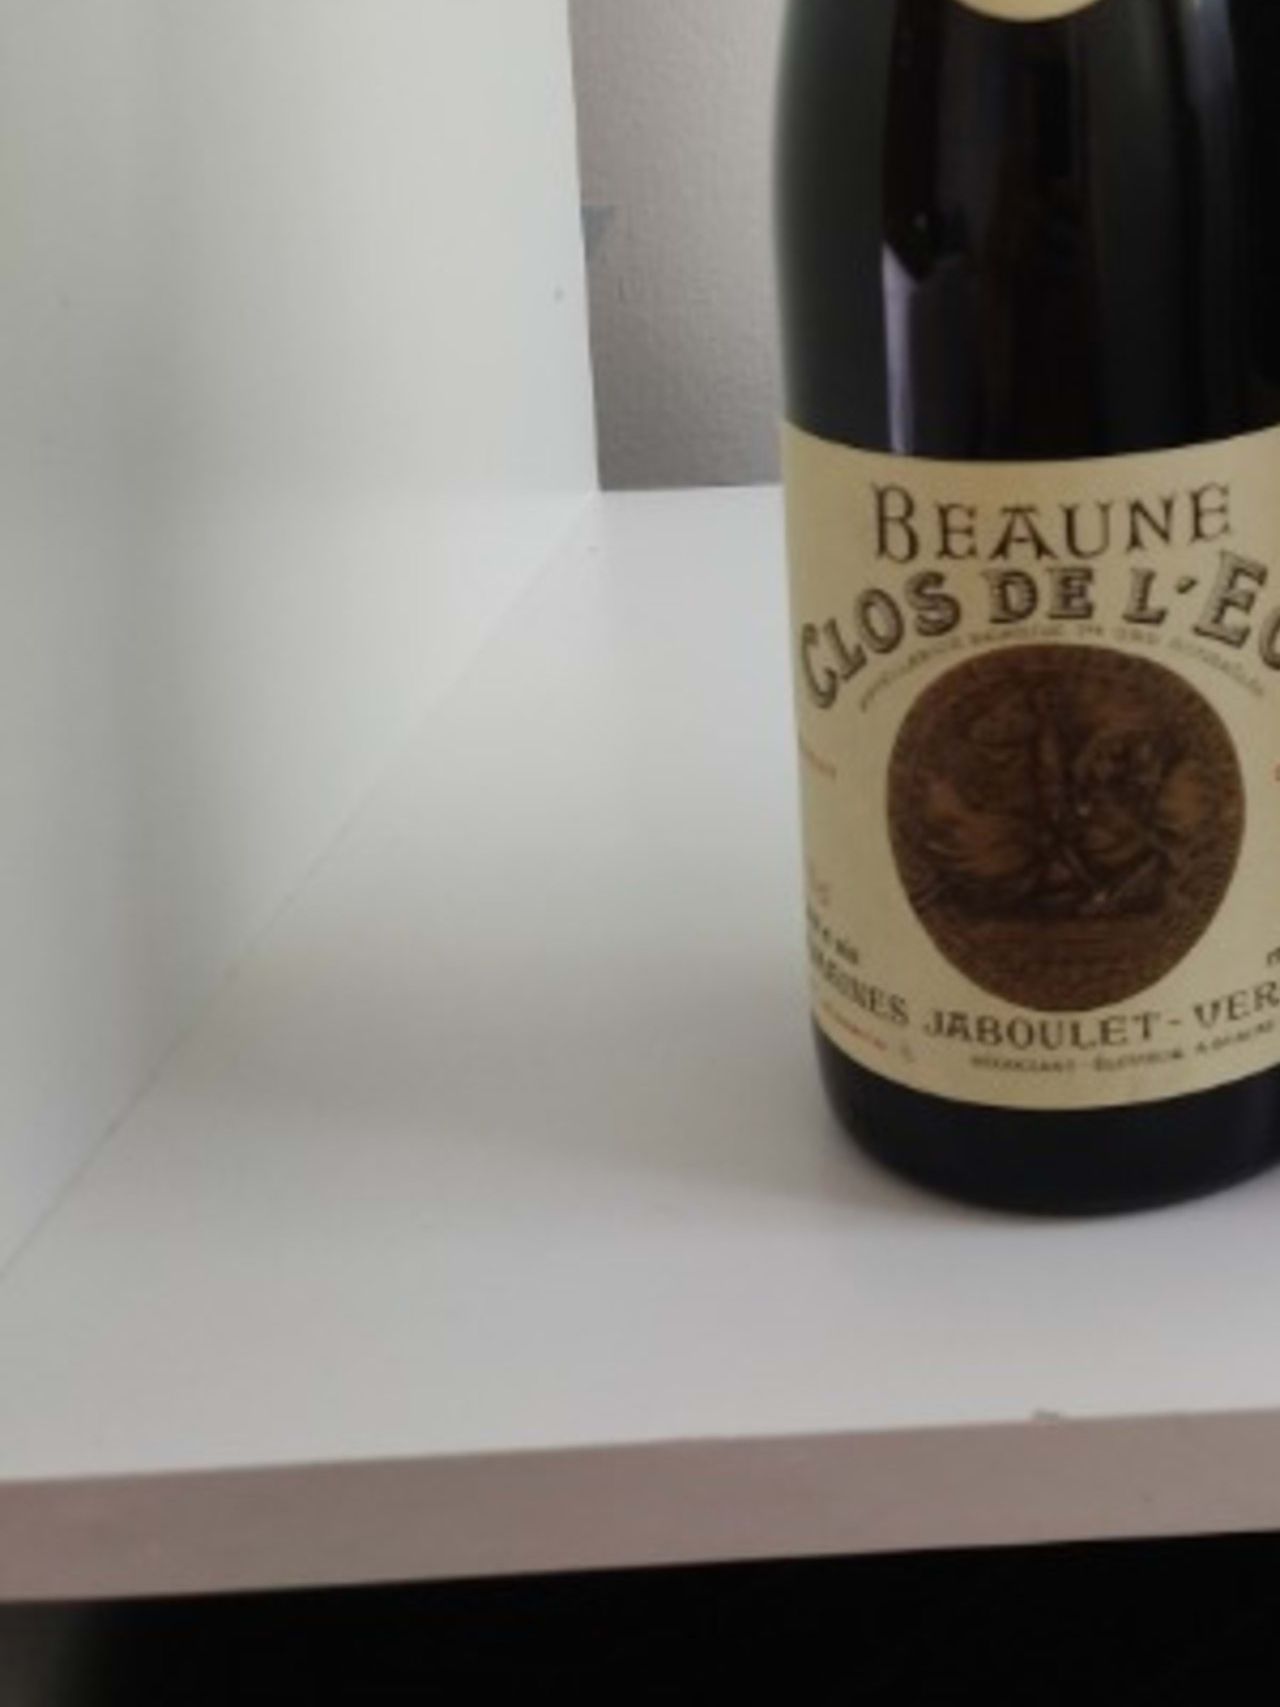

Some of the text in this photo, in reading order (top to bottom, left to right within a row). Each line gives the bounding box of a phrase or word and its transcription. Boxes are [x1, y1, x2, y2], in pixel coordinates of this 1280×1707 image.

[870, 481, 1232, 564] BEAUNE
[800, 569, 962, 710] CLOS
[981, 565, 1095, 624] DE
